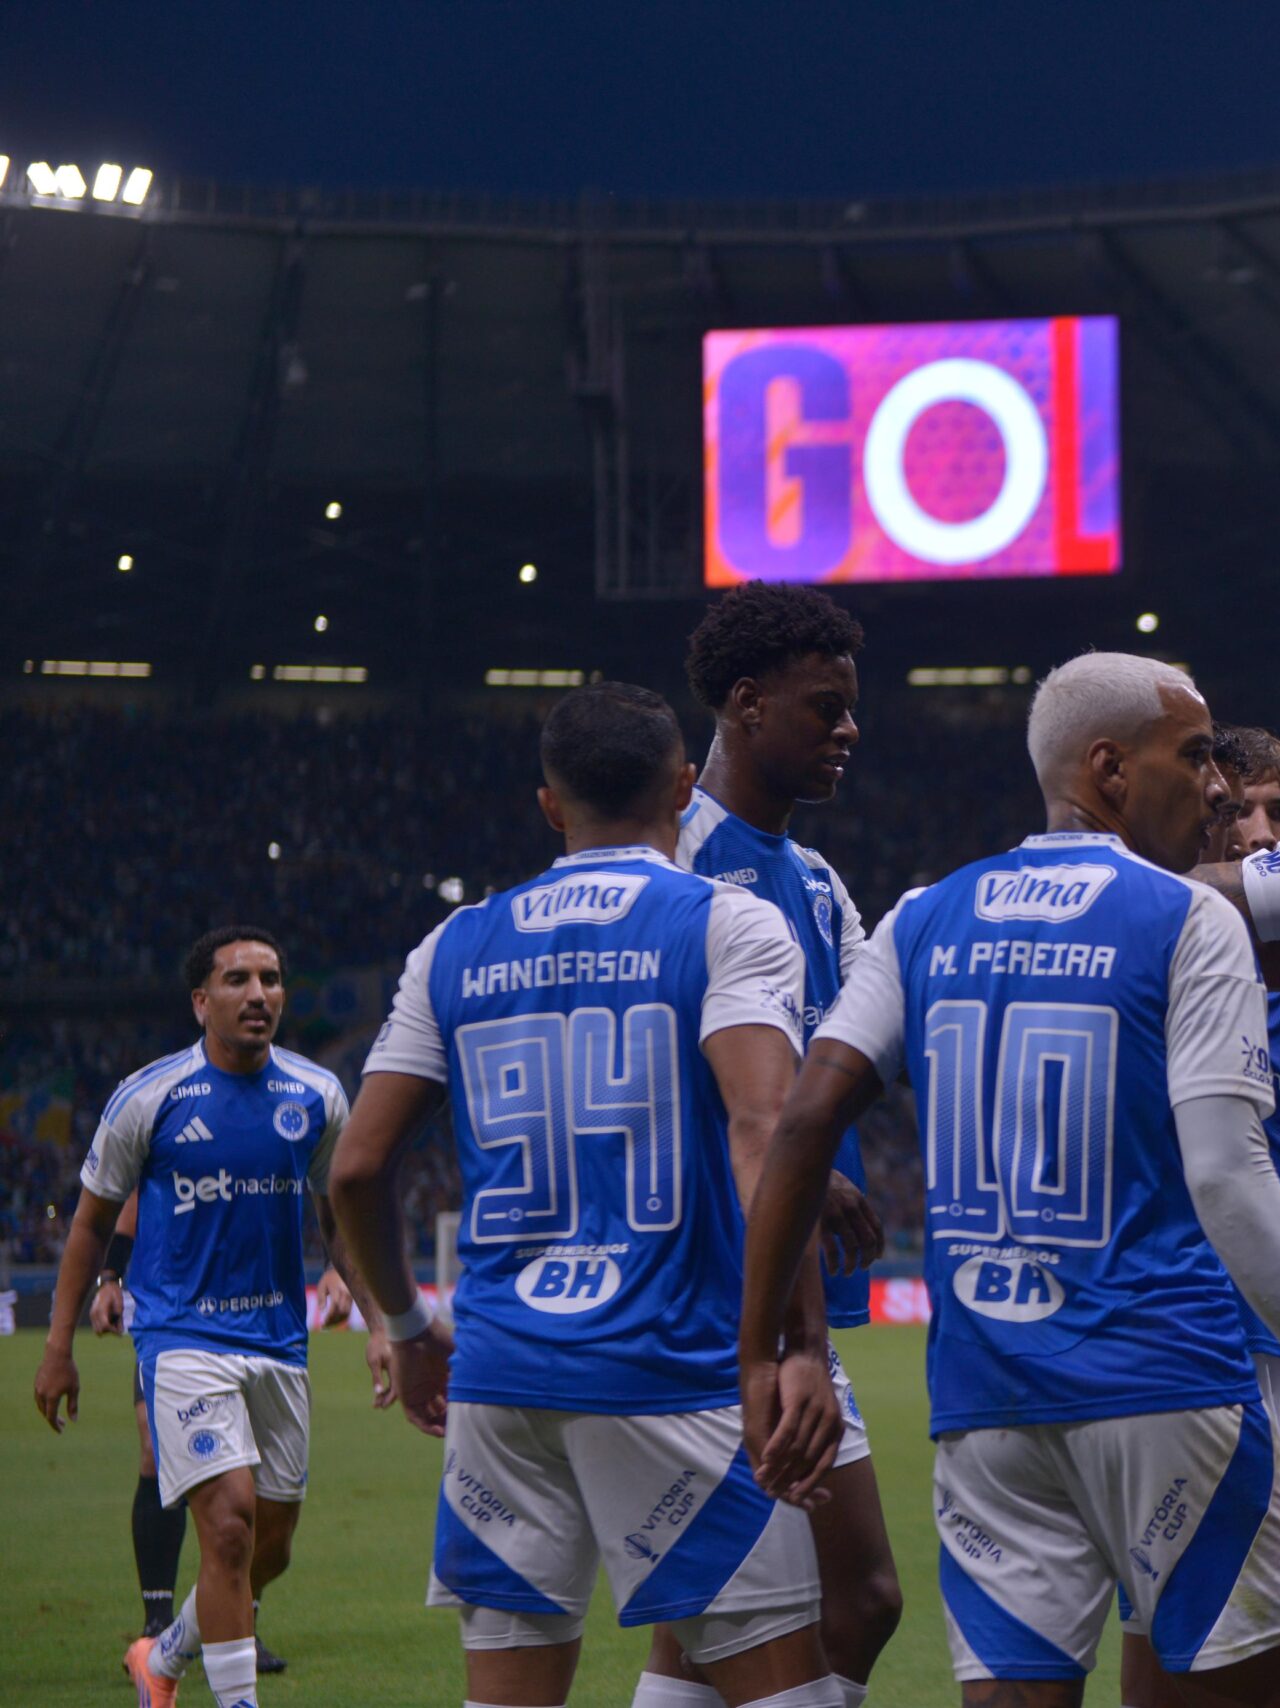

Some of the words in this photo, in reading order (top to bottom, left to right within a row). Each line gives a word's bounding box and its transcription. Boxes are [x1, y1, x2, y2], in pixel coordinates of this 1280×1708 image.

[717, 316, 1118, 584] GOL
[523, 884, 627, 921] Vilma
[984, 874, 1090, 907] Vilma
[461, 949, 661, 998] WANDERSON
[929, 944, 958, 977] M.
[968, 940, 1117, 979] PEREIRA
[170, 1083, 212, 1101] CIMED
[267, 1080, 305, 1094] CIMED
[454, 1003, 682, 1245] 94
[924, 999, 1120, 1248] 10
[529, 1261, 608, 1299] BH
[974, 1261, 1052, 1305] BH
[460, 1495, 492, 1522] CUP
[668, 1492, 695, 1525] CUP
[1163, 1503, 1187, 1541] CUP
